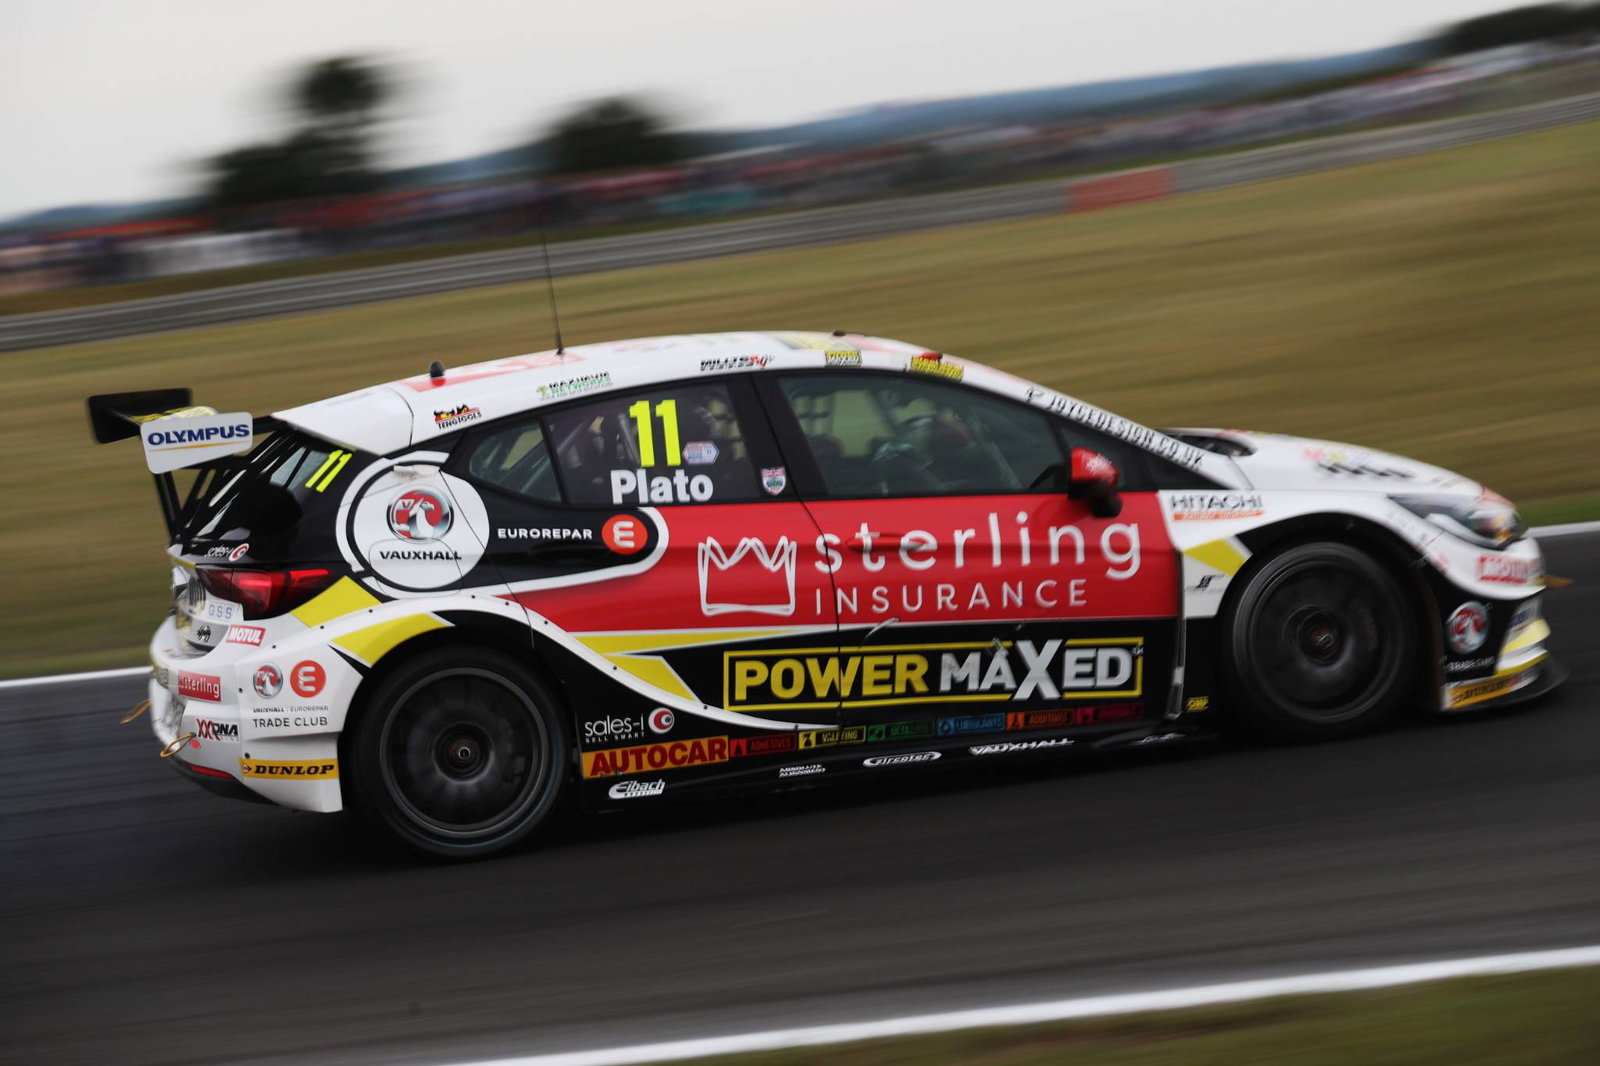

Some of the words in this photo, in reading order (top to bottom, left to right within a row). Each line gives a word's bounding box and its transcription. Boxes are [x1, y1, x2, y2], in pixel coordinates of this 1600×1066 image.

[147, 424, 250, 446] OLYMPUS
[629, 399, 682, 468] 11
[305, 449, 350, 493] 11
[610, 468, 715, 505] Plato
[1171, 494, 1263, 510] HITACHI
[497, 528, 594, 541] EUROREPAR
[814, 511, 1142, 580] sterling
[379, 550, 463, 562] VAUXHALL
[815, 578, 1088, 616] INSURANCE
[229, 627, 262, 643] MOTUL
[734, 653, 930, 702] POWER
[938, 639, 1134, 701] MAXED
[184, 676, 221, 699] sterling
[252, 718, 290, 728] TRADE
[294, 716, 328, 727] CLUB
[614, 731, 646, 743] SMART
[590, 738, 728, 778] AUTOCAR
[253, 764, 336, 776] DUNLOP
[609, 778, 667, 800] Eibach
